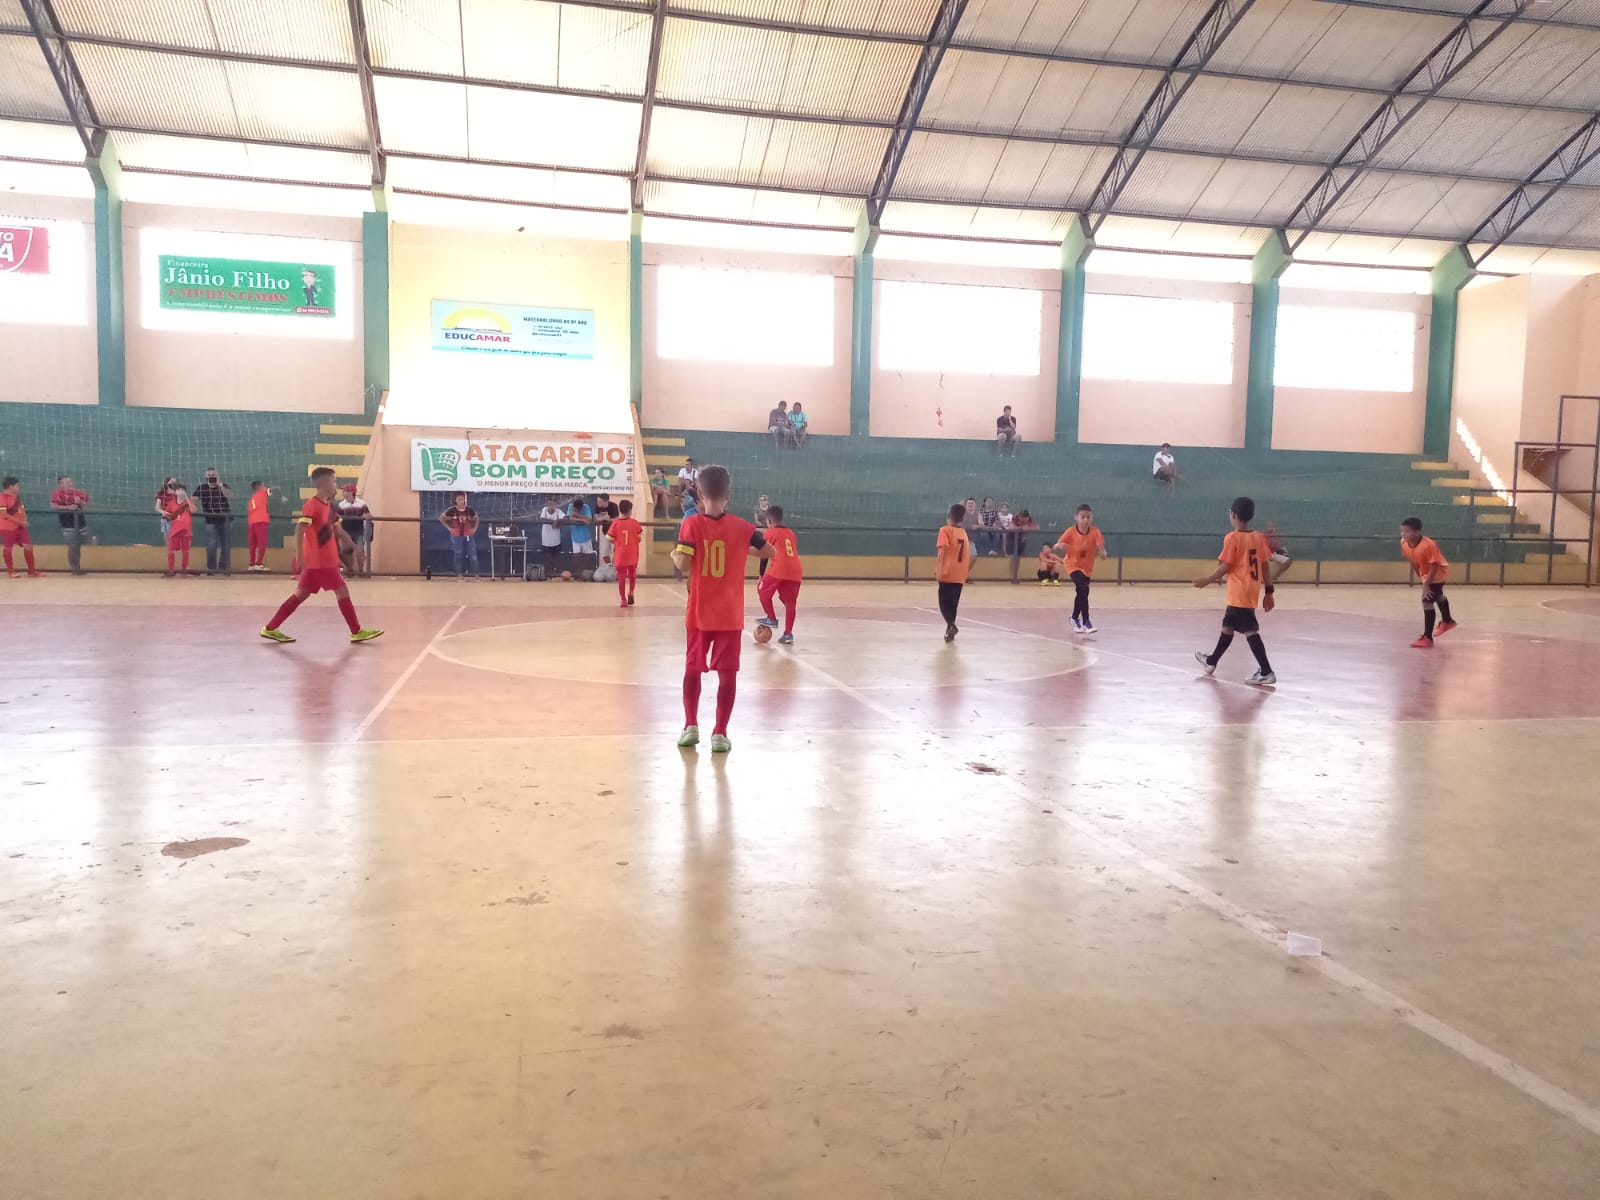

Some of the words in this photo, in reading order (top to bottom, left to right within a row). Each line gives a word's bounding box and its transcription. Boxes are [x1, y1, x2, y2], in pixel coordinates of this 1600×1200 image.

[167, 259, 209, 269] Financeira
[164, 267, 225, 287] Jânio
[231, 270, 290, 290] Filho
[444, 332, 511, 343] EDUCAMAR
[465, 444, 626, 465] ATACAREJO
[469, 463, 528, 479] BOM
[535, 464, 616, 484] PREÇO
[510, 480, 534, 489] PREÇO
[701, 539, 726, 578] 10
[957, 538, 965, 563] 7
[1248, 548, 1259, 582] 5
